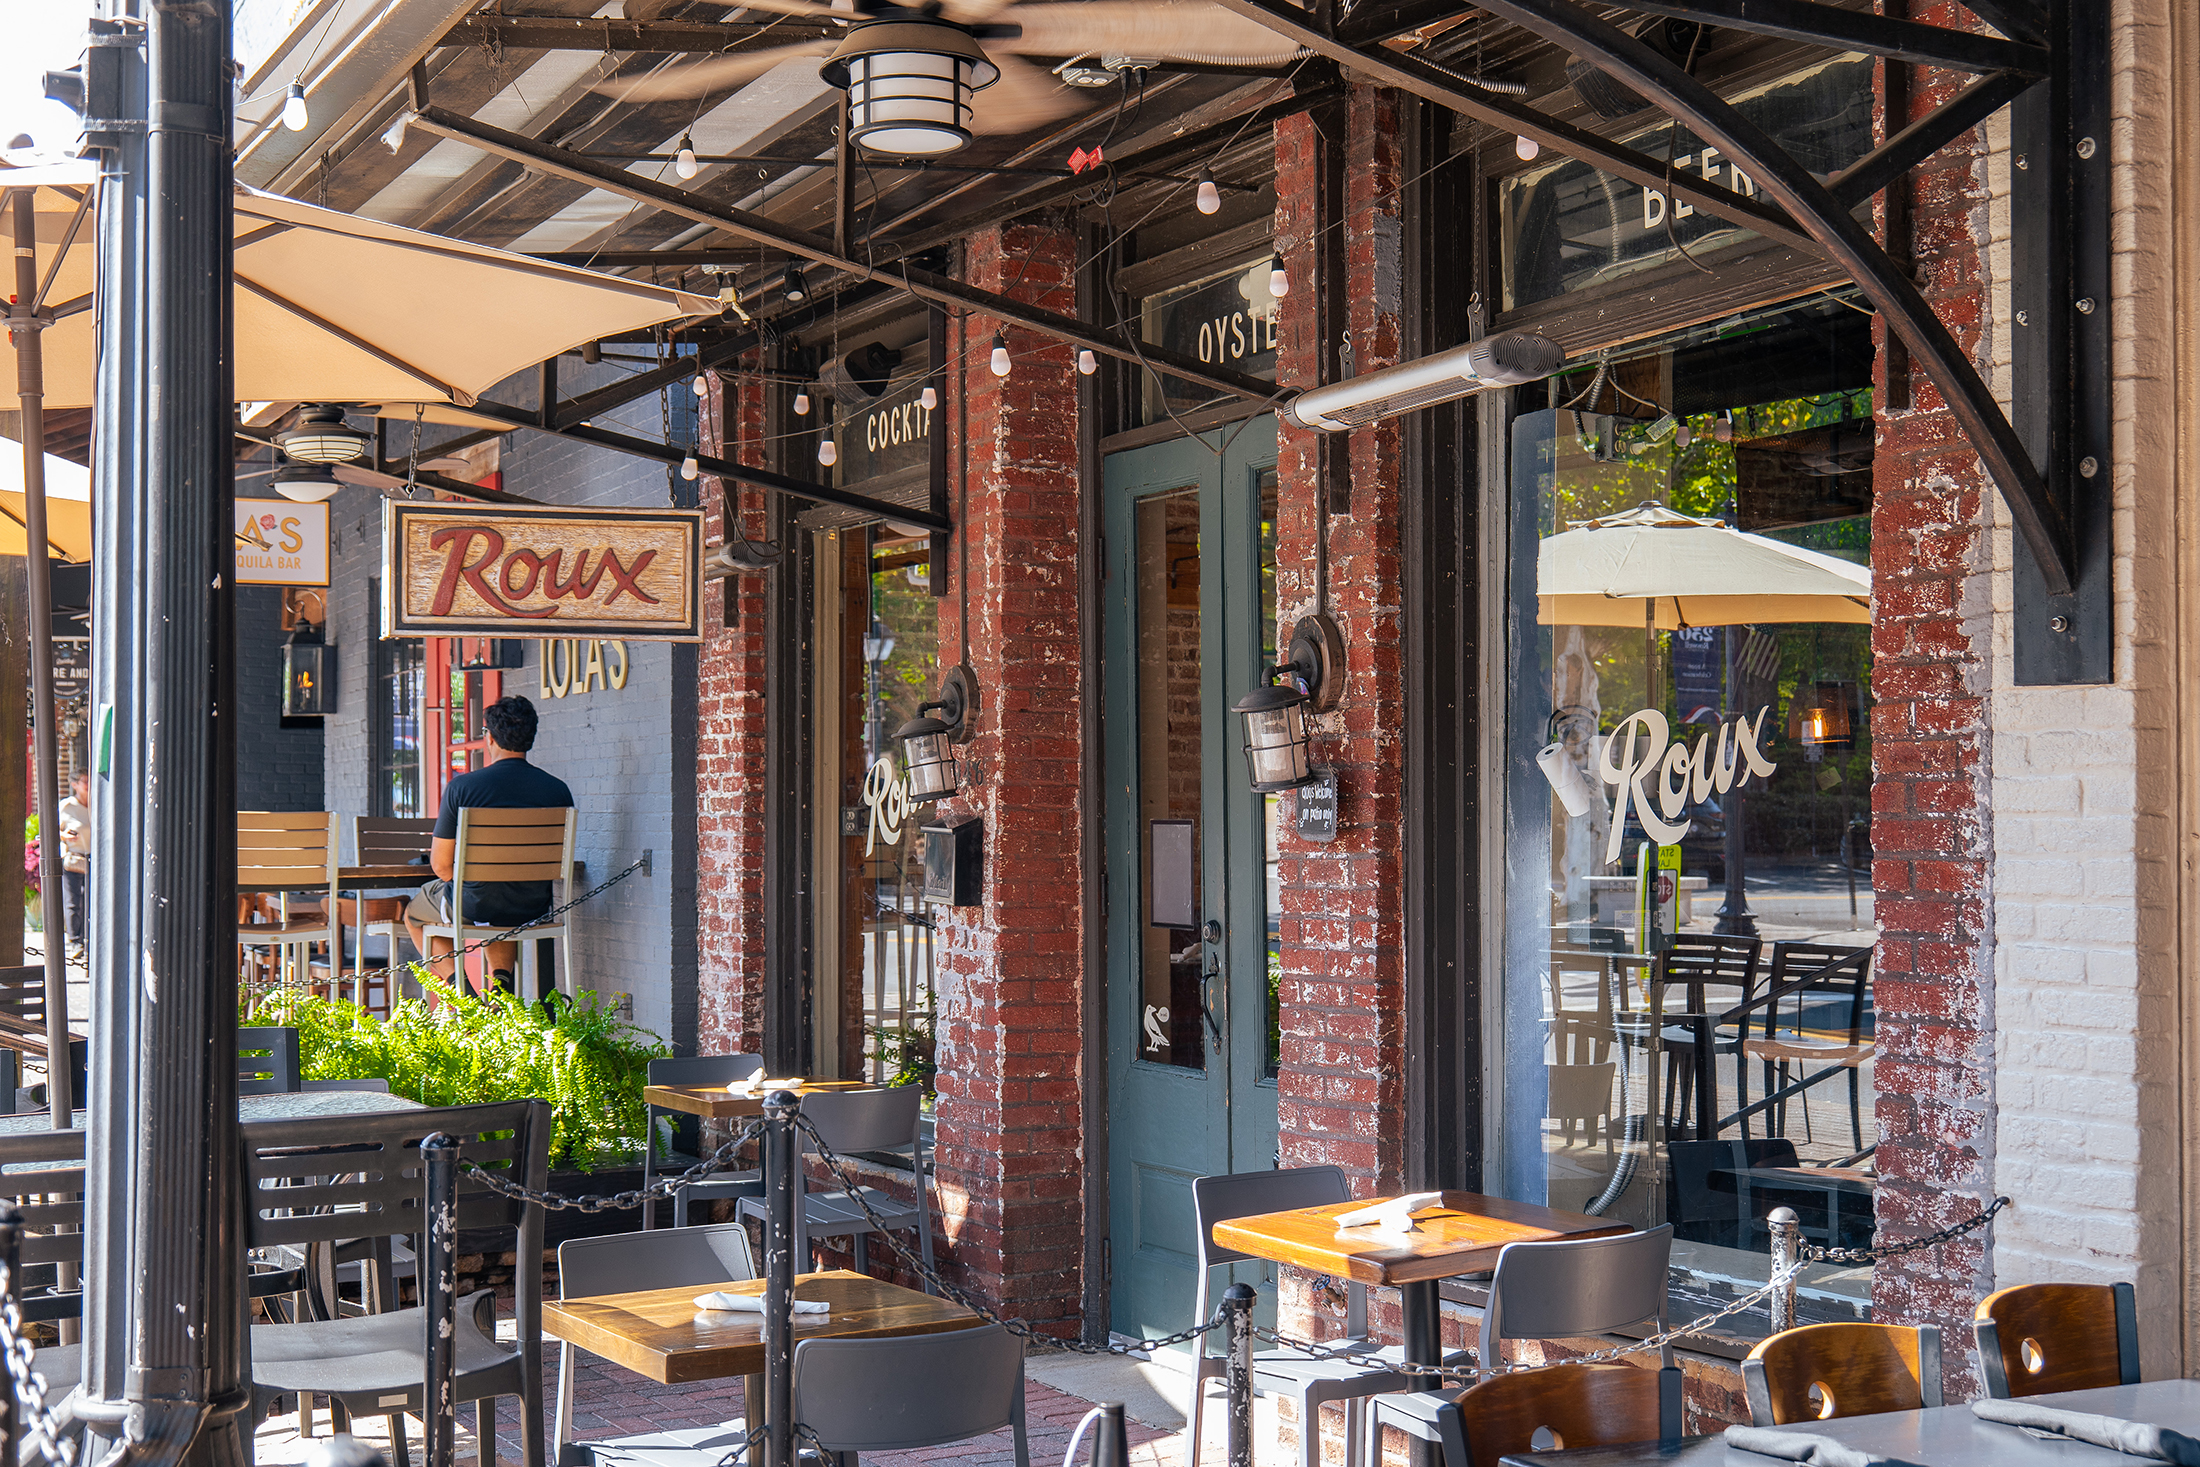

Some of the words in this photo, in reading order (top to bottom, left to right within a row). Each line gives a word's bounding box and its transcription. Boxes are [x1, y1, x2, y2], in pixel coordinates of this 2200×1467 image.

[1198, 301, 1277, 364] OYSTE
[236, 555, 273, 568] QUILA
[277, 556, 301, 569] BAR
[430, 526, 660, 618] Roux
[863, 758, 933, 857] Rou
[1600, 705, 1777, 865] Roux
